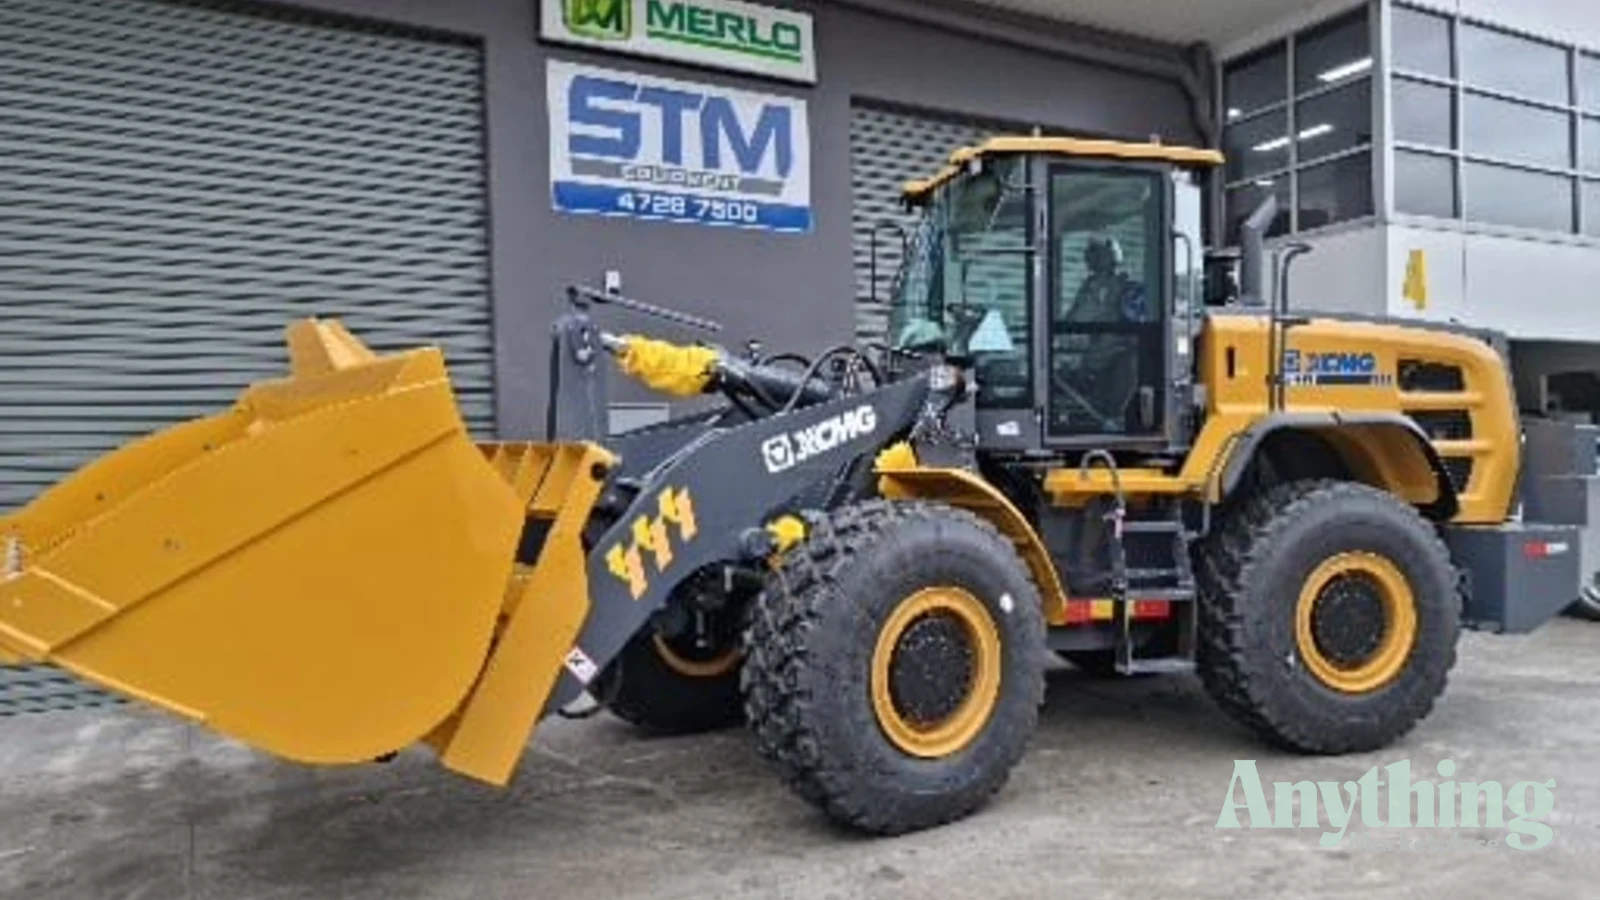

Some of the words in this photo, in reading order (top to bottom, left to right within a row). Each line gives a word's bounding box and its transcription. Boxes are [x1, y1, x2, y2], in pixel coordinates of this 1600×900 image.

[647, 1, 801, 50] MERLO
[568, 74, 793, 179] STM
[618, 192, 686, 217] 4728
[692, 198, 758, 223] 7500
[1402, 249, 1426, 310] 4
